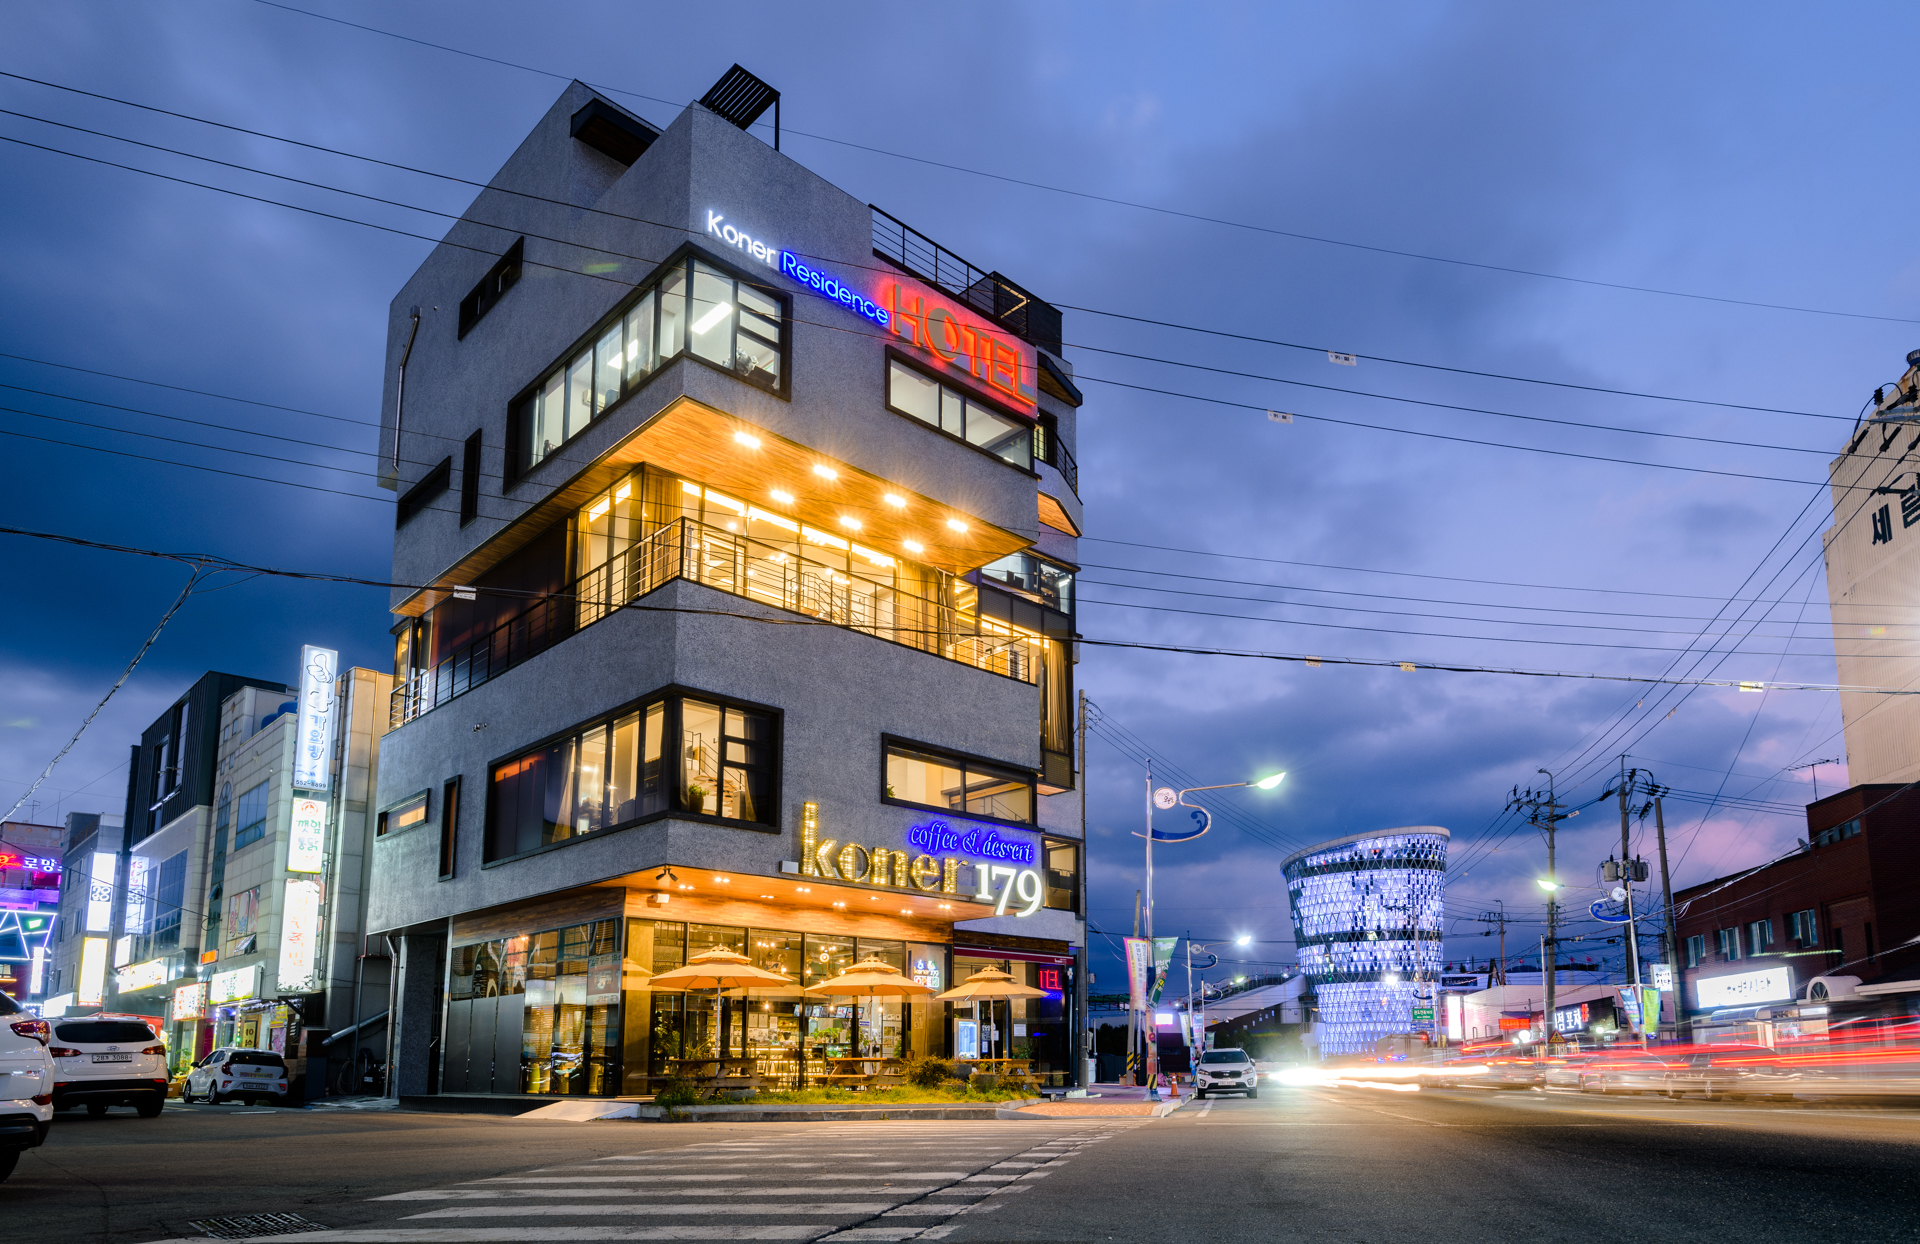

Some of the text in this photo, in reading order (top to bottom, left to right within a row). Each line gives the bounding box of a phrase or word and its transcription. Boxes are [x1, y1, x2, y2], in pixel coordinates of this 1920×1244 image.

[708, 211, 1037, 406] Koner Residence HOTEL
[295, 779, 327, 789] 552-8899
[295, 819, 321, 835] 깻잎
[296, 836, 320, 852] 통닭
[911, 822, 1033, 862] coffee & dessert
[803, 802, 1042, 917] koner 179
[111, 1053, 129, 1061] 3088
